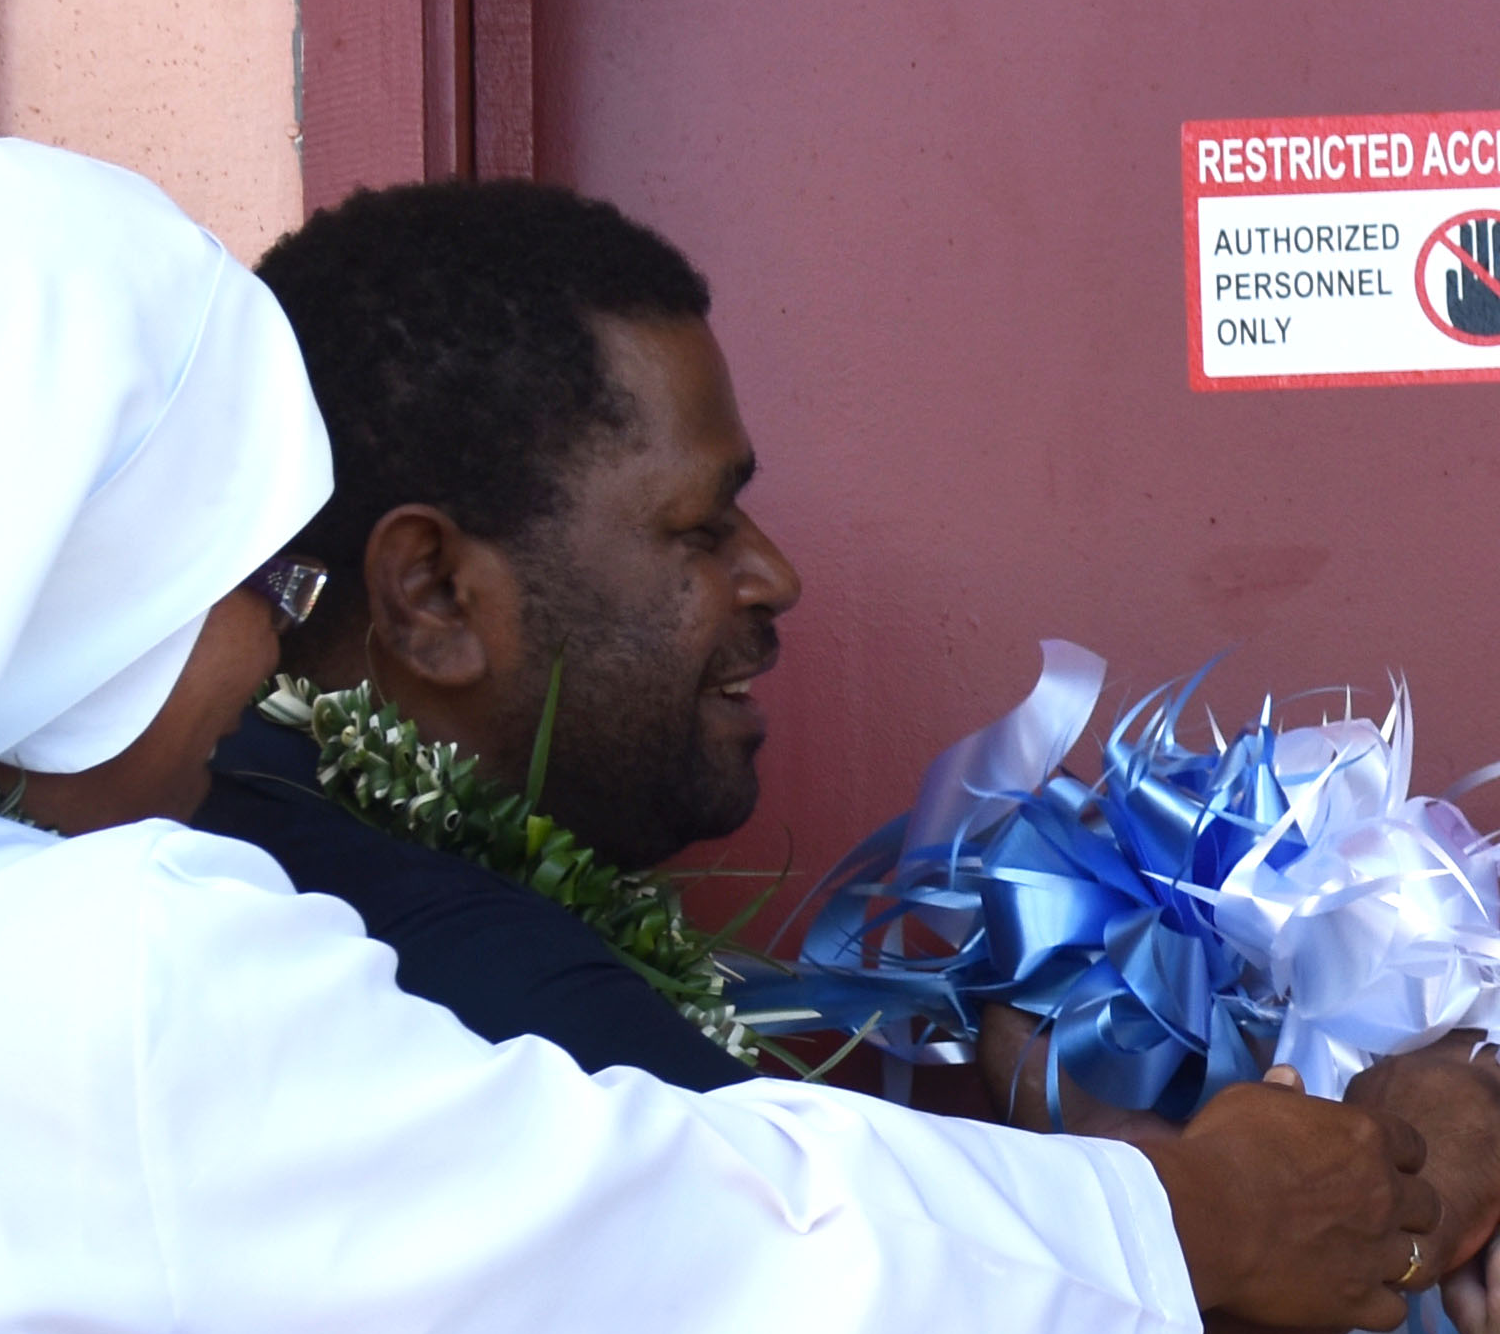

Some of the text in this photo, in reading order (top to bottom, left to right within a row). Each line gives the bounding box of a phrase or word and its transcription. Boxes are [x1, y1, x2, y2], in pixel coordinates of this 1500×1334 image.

[1199, 133, 1414, 183] RESTRICTED
[1214, 224, 1400, 256] AUTHORIZED
[1215, 269, 1393, 300] PERSONNEL
[1217, 316, 1292, 345] ONLY
